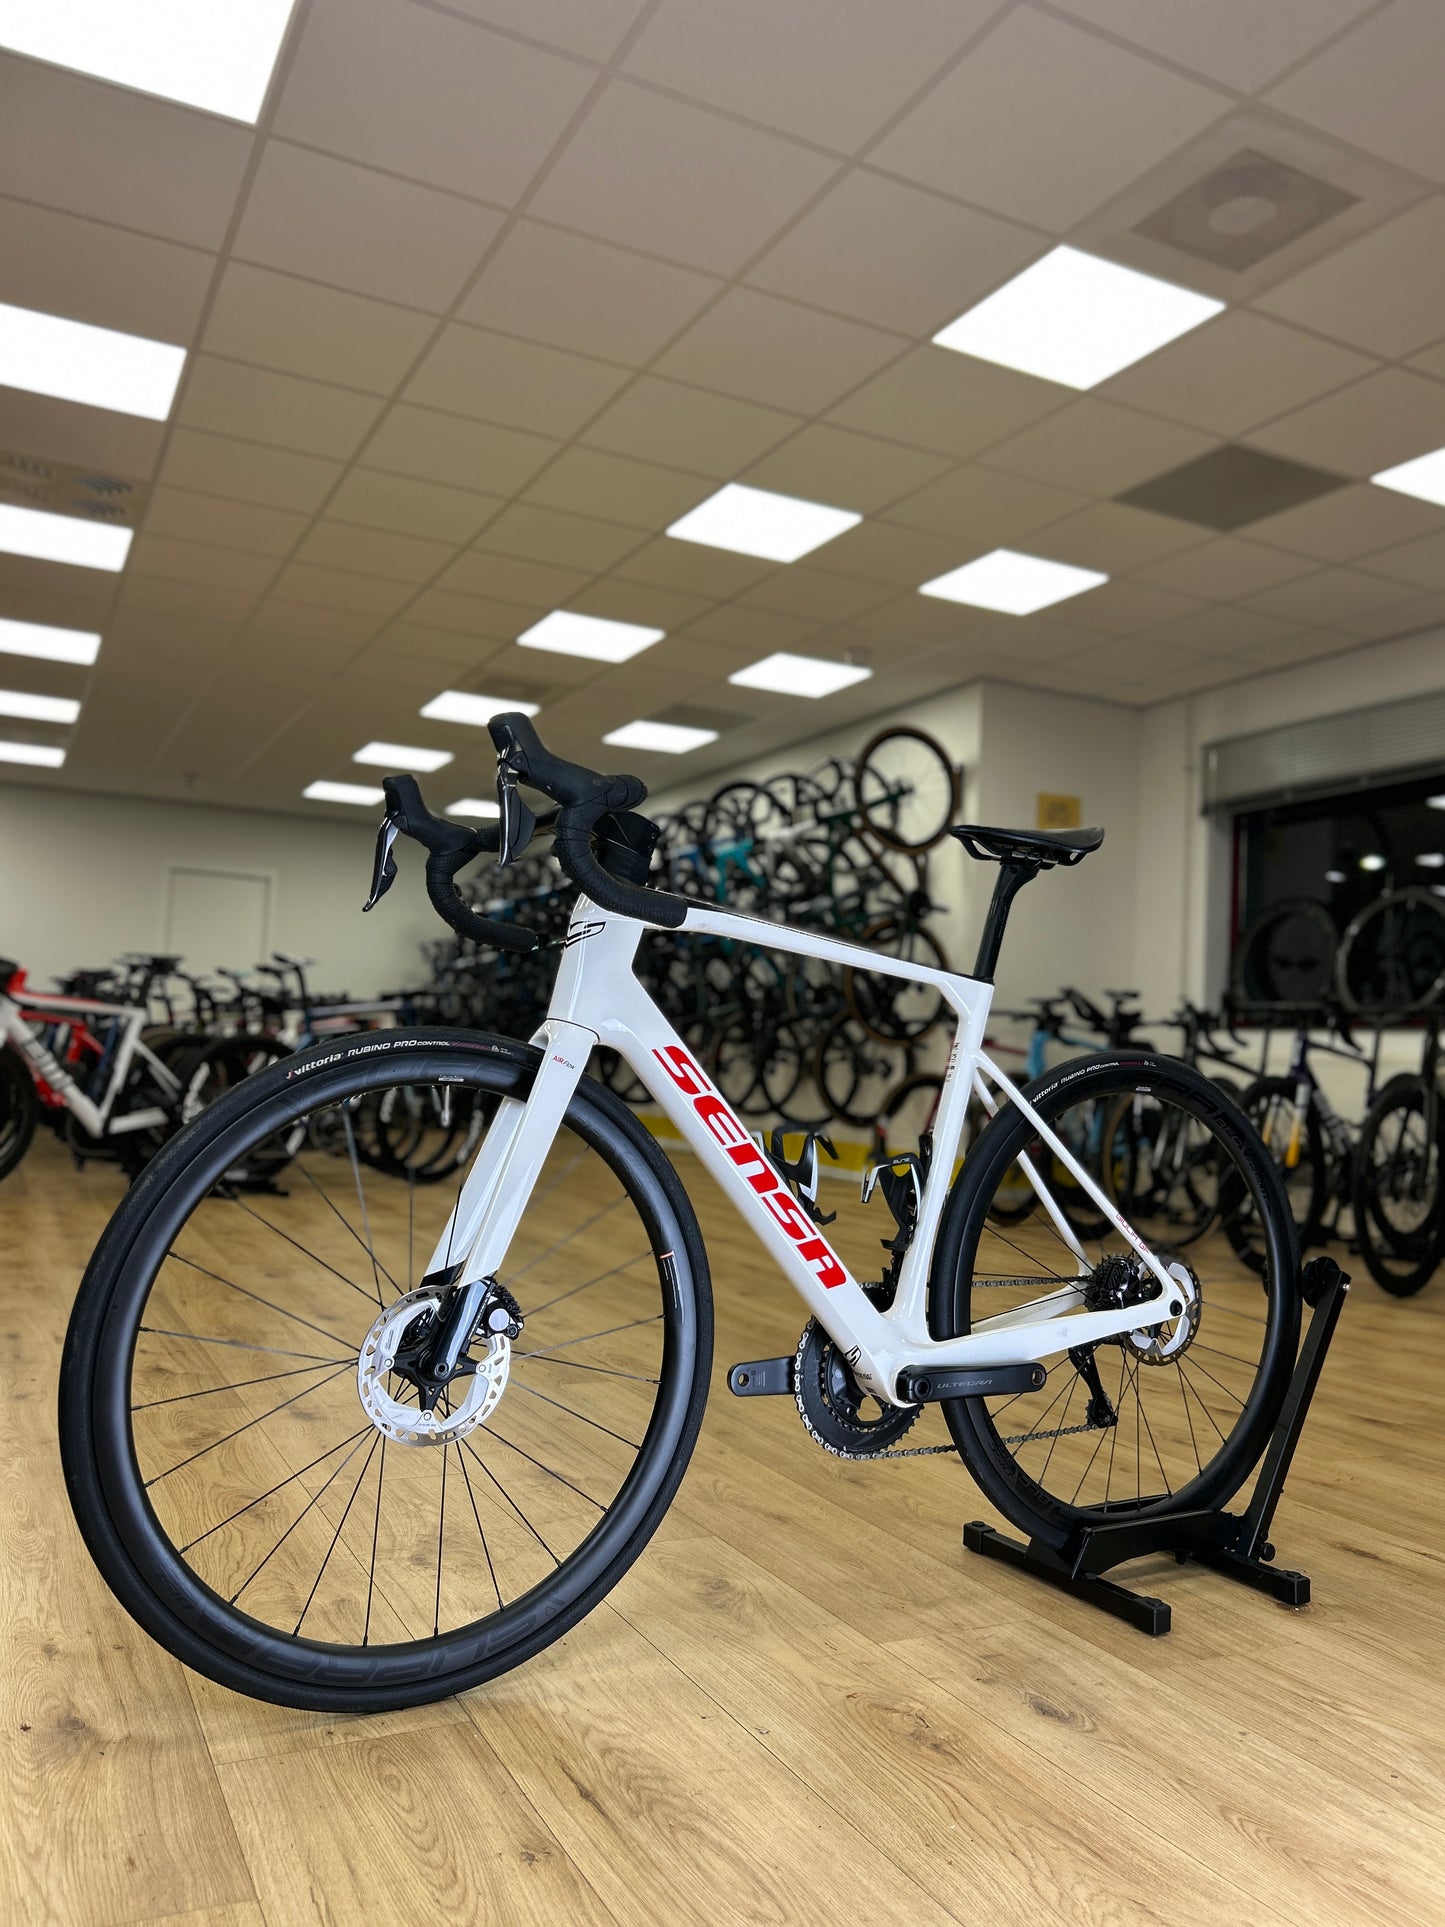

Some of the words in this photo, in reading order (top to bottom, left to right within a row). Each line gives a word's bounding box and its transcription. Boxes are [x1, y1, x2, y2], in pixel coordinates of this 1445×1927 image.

[293, 1053, 343, 1077] vittoria
[347, 1042, 391, 1058] RUBINO
[393, 1039, 418, 1048] PRO
[1032, 1082, 1059, 1103] vittoria
[1060, 1069, 1086, 1084] RUBINO
[1086, 1064, 1100, 1073] PRO
[1116, 1213, 1138, 1241] GIULIA
[936, 1379, 993, 1389] ULTEGRA
